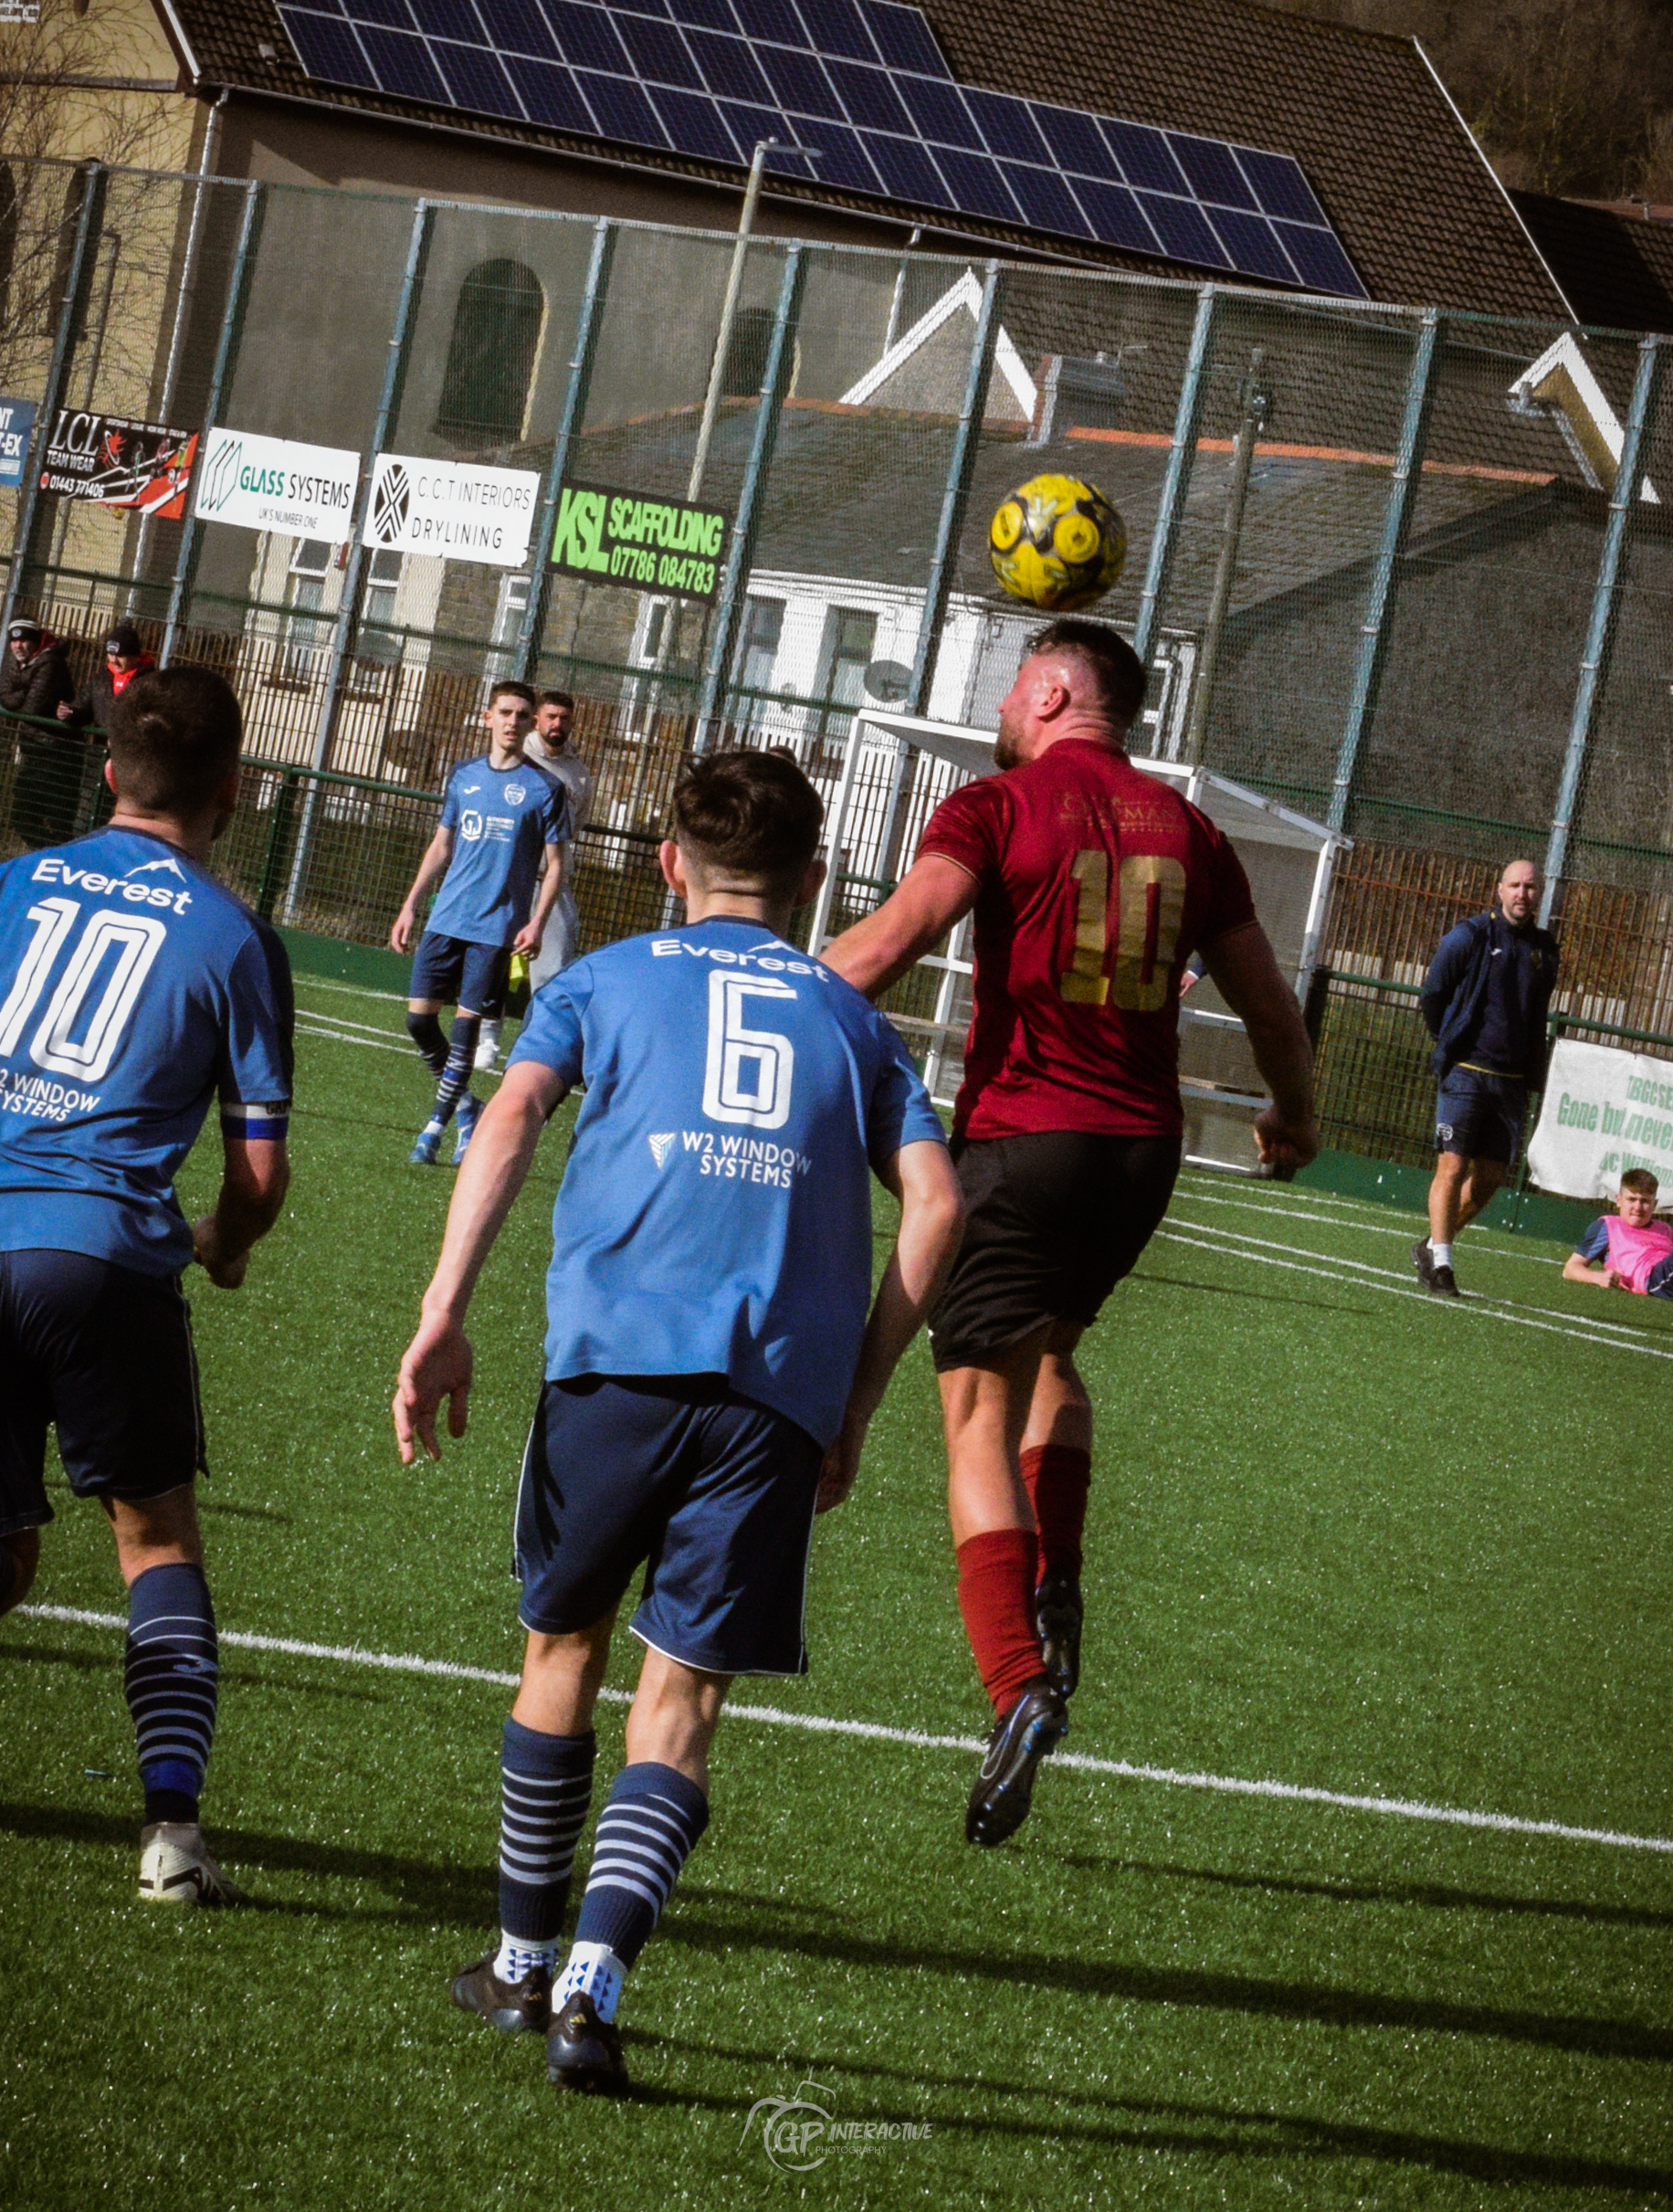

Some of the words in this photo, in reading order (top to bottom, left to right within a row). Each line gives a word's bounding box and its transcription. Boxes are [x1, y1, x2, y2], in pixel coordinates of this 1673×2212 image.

[49, 410, 101, 456] LCL
[47, 450, 69, 468] TEAM
[69, 456, 95, 472] WEAR
[49, 475, 75, 492] 01443
[240, 466, 285, 496] GLASS
[288, 472, 351, 510] SYSTEMS
[458, 481, 531, 511] INTERIORS
[274, 511, 303, 526] NUMBER
[303, 515, 318, 529] ONE
[411, 517, 503, 550] DRYLINING
[552, 488, 609, 573] KSL
[608, 496, 724, 557] SCAFFOLDING
[610, 546, 656, 582] 07786
[658, 557, 715, 595] 084783
[31, 858, 193, 915] Everest
[1060, 848, 1186, 1011] 10
[651, 939, 829, 983] Everest
[0, 897, 167, 1082] 10
[702, 969, 797, 1130] 6
[14, 1073, 100, 1112] WINDOW
[1557, 1092, 1598, 1132] Gone
[682, 1132, 714, 1153] W2
[721, 1134, 812, 1175] WINDOW
[700, 1155, 792, 1188] SYSTEMS
